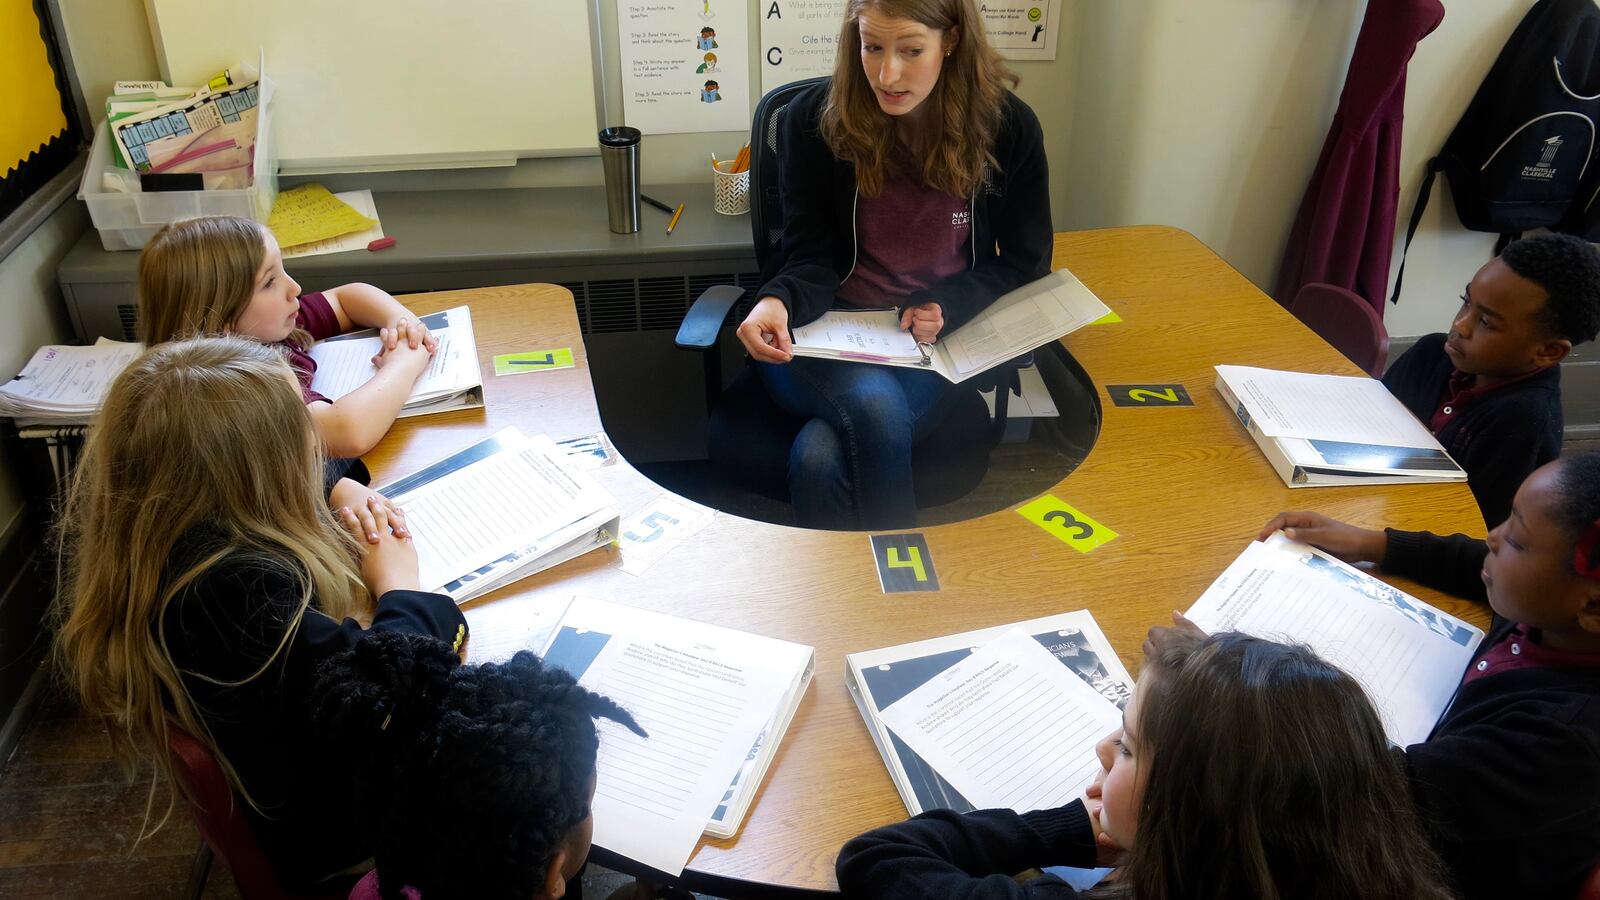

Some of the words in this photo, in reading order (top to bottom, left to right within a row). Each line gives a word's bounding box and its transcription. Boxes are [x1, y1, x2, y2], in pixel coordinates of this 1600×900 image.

[767, 1, 781, 19] A
[802, 35, 818, 44] Cite
[821, 34, 832, 43] the
[767, 46, 782, 66] C
[1521, 170, 1553, 178] CLASSICAL
[1523, 166, 1557, 174] NASHVILLE
[1128, 388, 1179, 402] 2
[623, 511, 680, 543] 5
[1043, 510, 1094, 540] 3
[887, 547, 928, 581] 4
